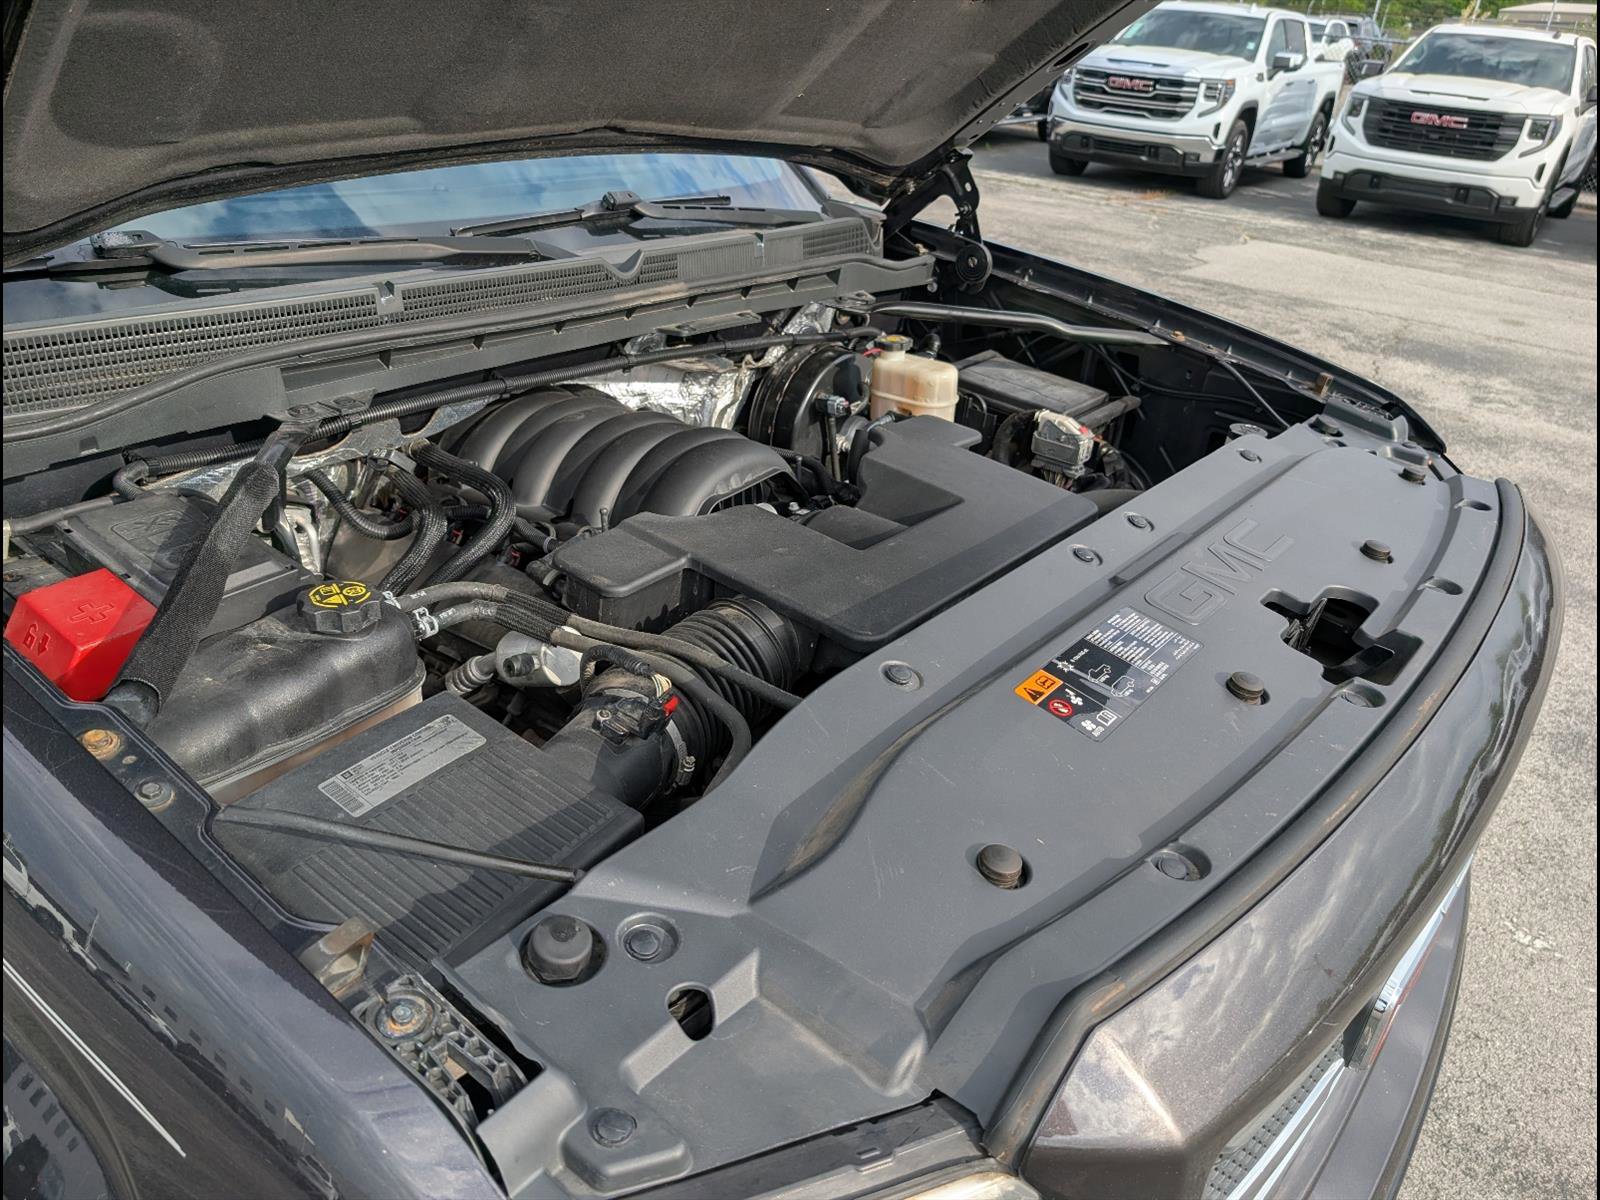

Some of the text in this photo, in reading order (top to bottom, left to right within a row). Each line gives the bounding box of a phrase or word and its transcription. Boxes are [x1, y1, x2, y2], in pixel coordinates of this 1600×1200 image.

[1107, 76, 1154, 92] GMC
[1410, 111, 1469, 129] GMC
[1143, 517, 1295, 626] GMC
